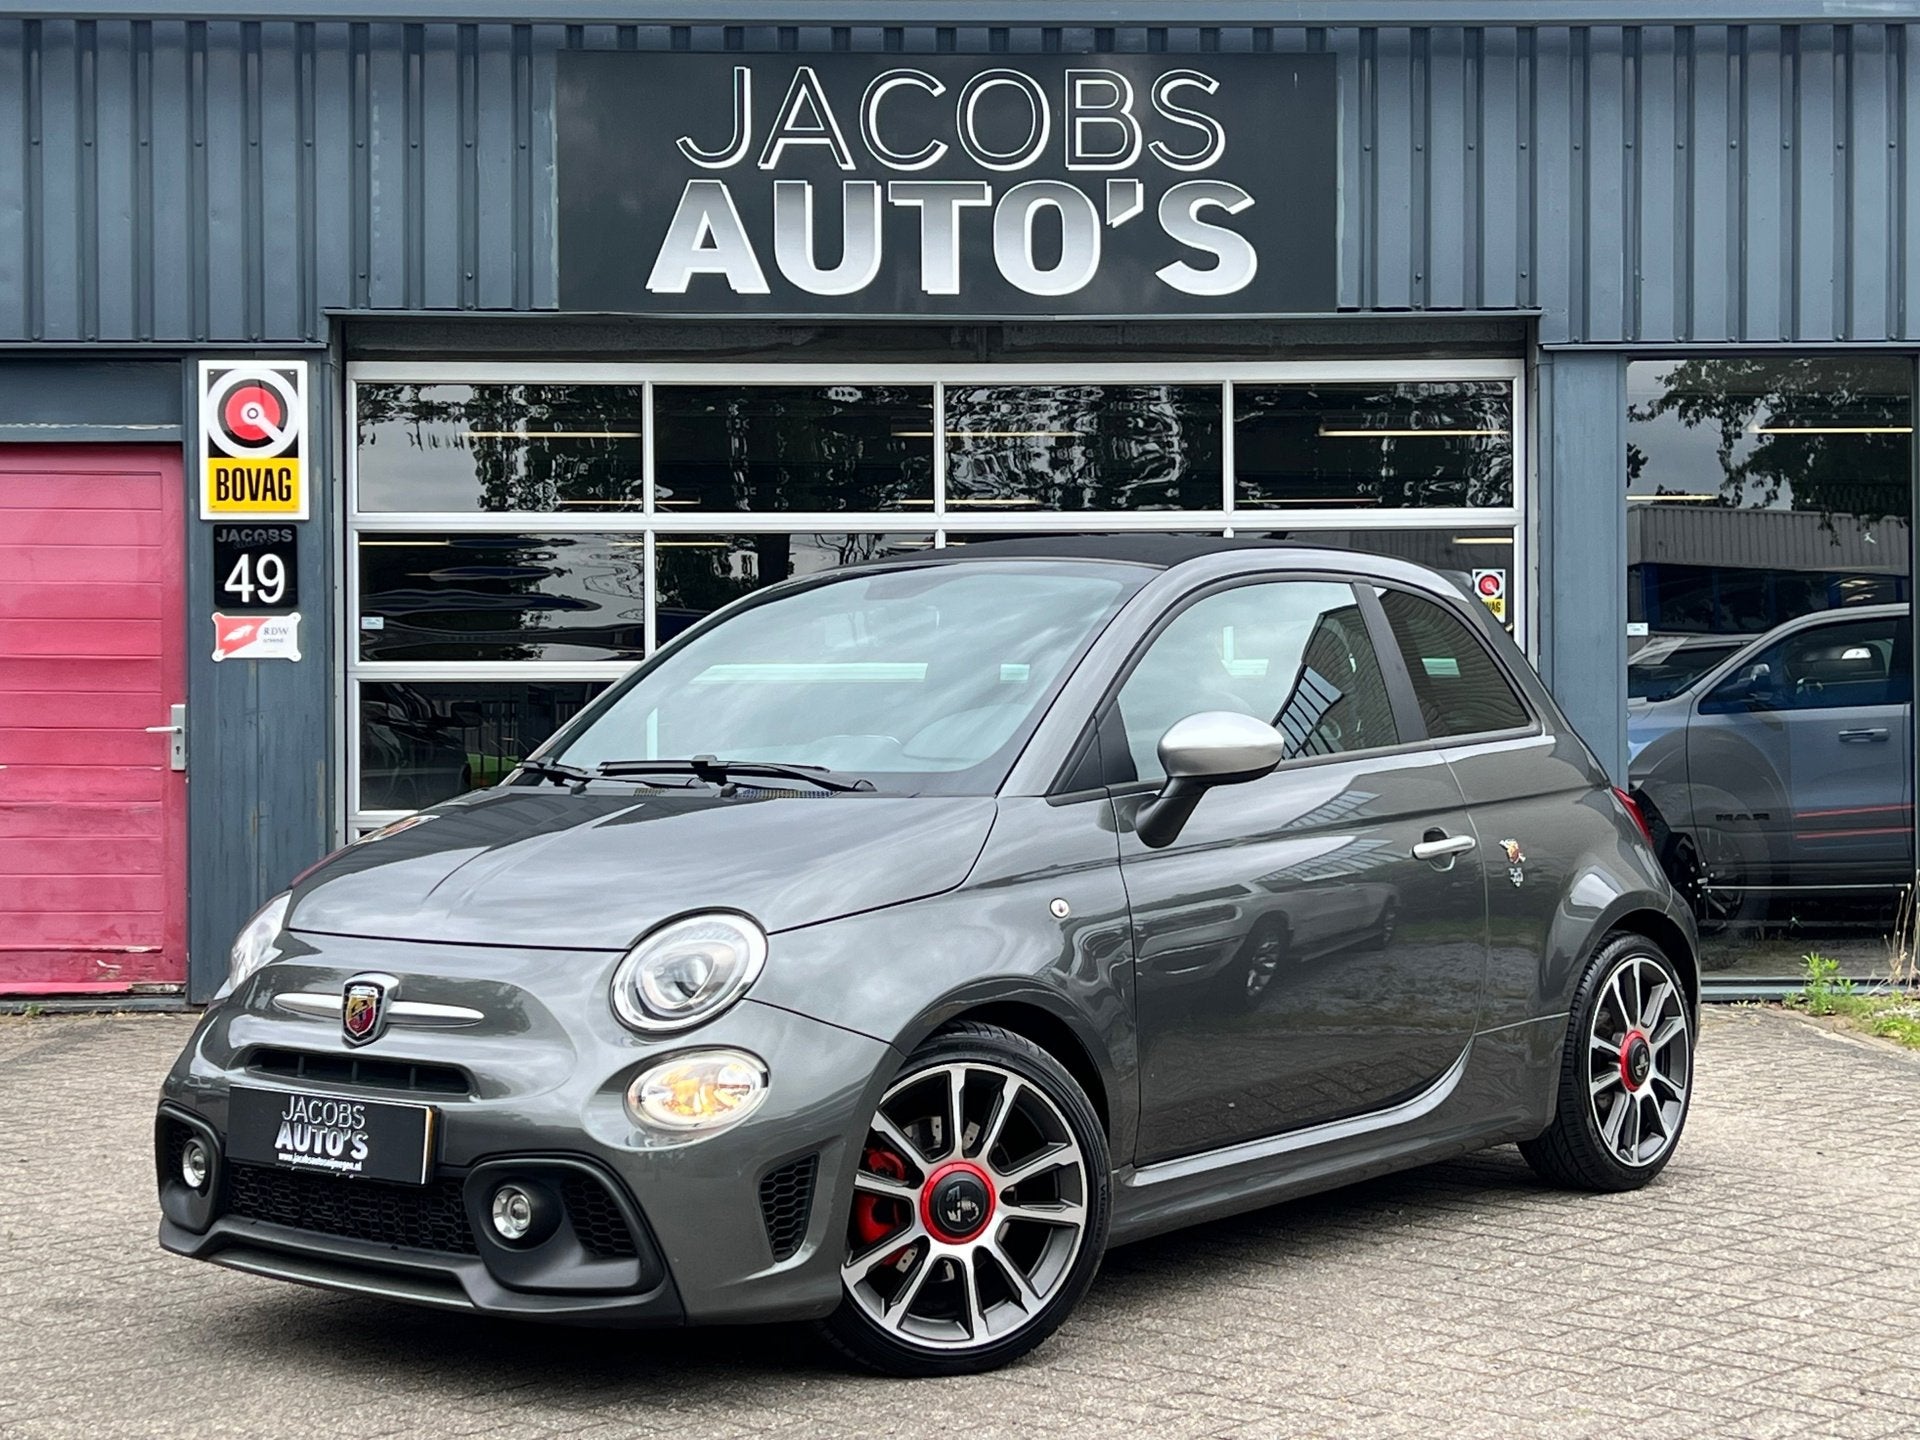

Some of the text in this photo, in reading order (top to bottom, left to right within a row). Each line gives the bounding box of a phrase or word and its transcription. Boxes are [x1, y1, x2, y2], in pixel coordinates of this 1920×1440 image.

[676, 66, 1226, 171] JACOBS
[645, 178, 1258, 296] AUTO'S
[216, 467, 291, 501] BOVAG
[216, 529, 293, 542] JACOBS
[224, 553, 285, 603] 49
[263, 627, 289, 635] RDW
[281, 1095, 366, 1129] JACOBS
[274, 1121, 369, 1160] AUTO'S
